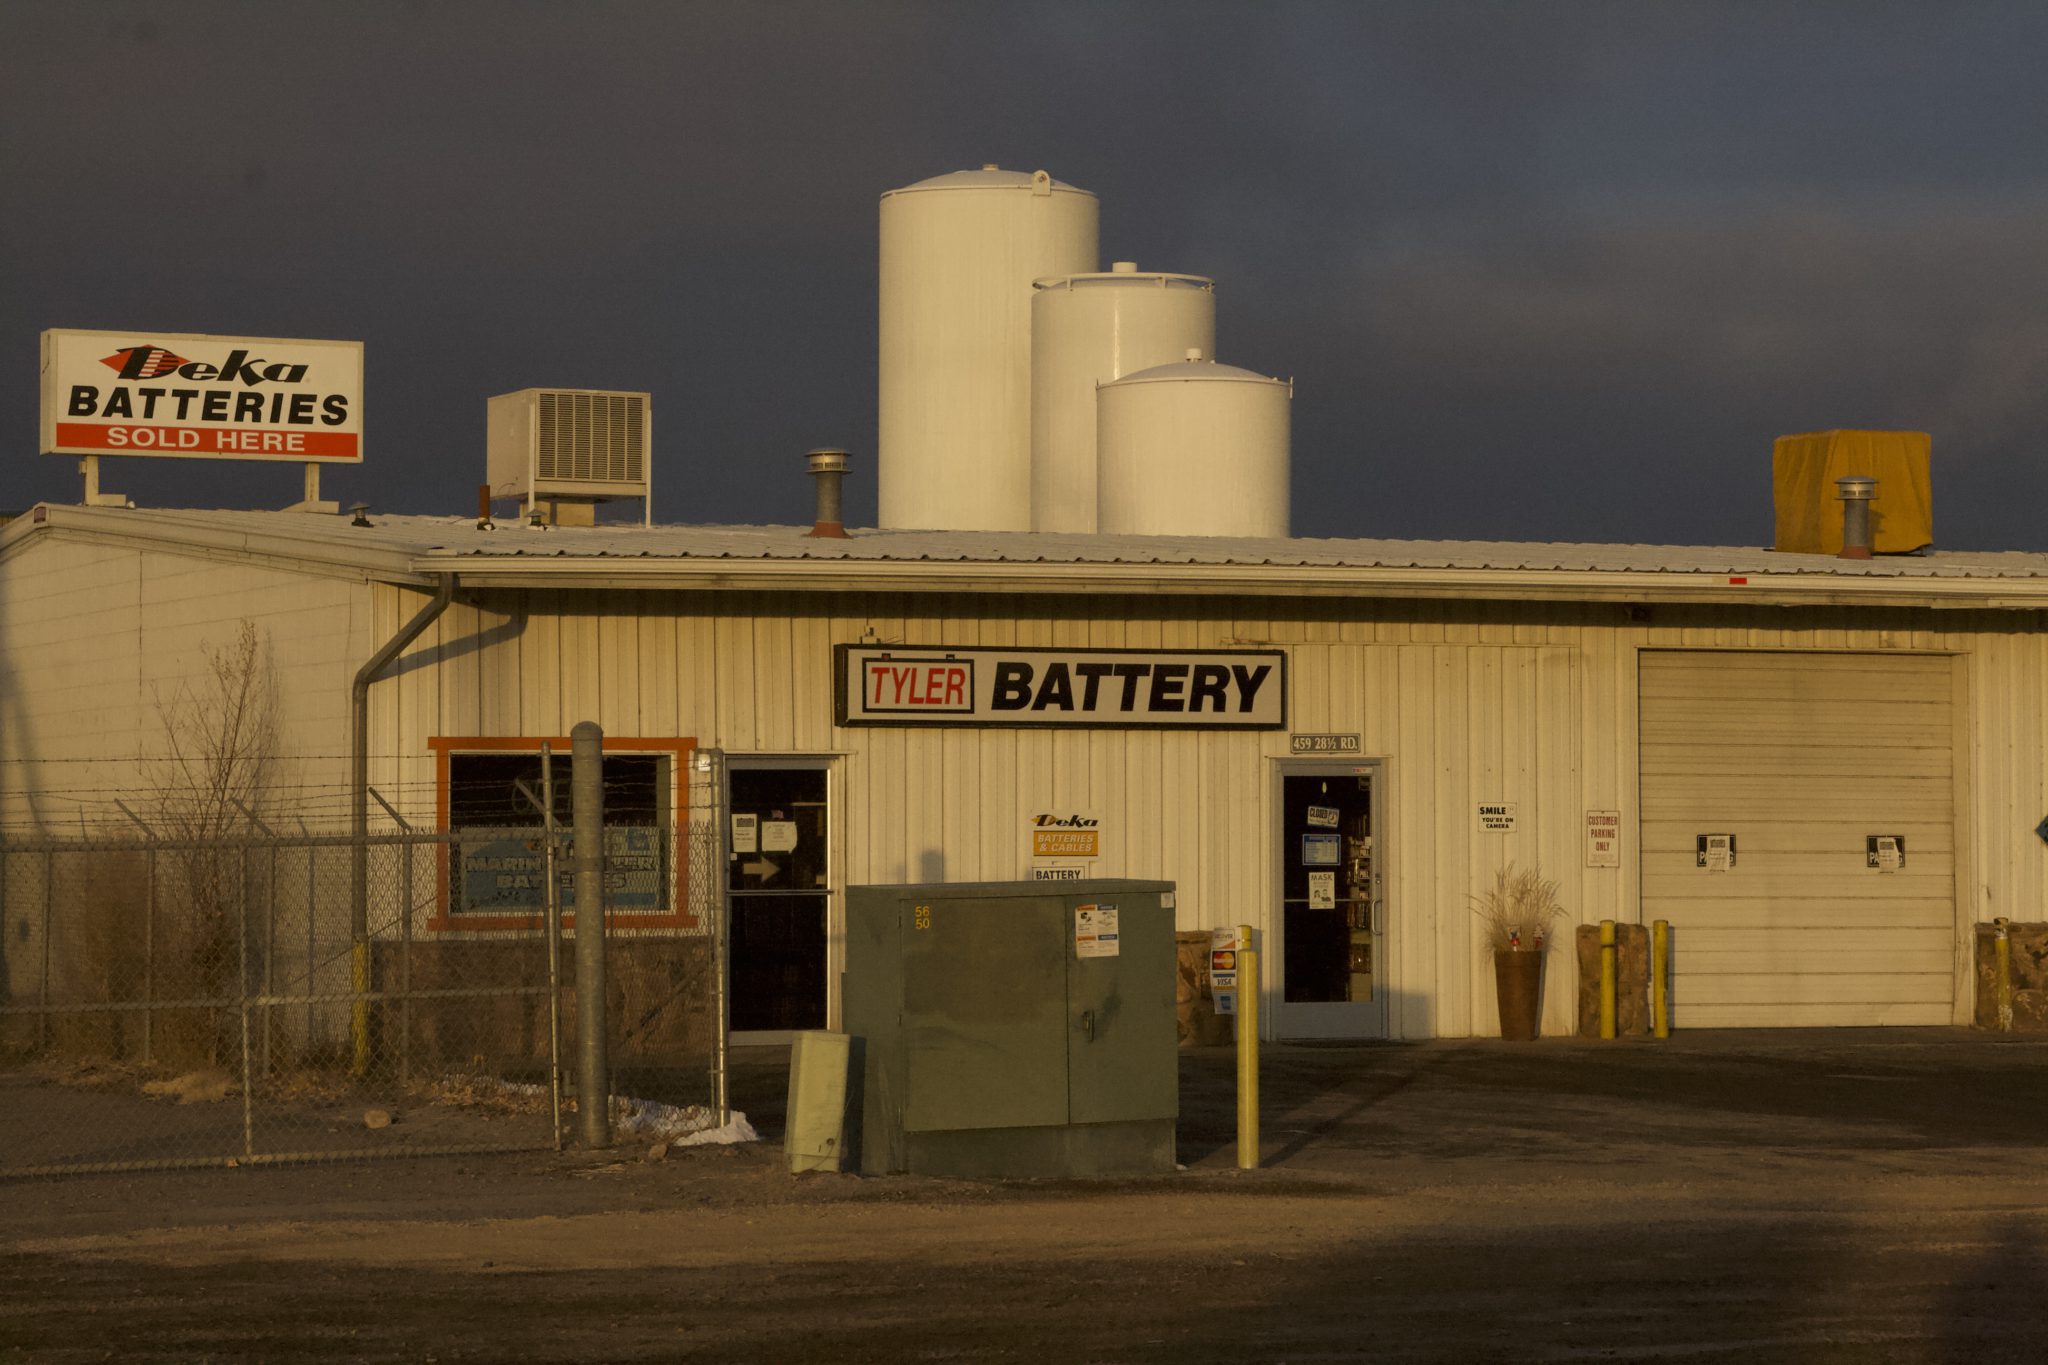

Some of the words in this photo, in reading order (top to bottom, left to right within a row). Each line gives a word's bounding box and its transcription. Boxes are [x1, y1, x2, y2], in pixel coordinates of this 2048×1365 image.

[115, 344, 309, 387] Deka
[67, 385, 349, 426] BATTERIES
[107, 427, 200, 448] SOLD
[216, 431, 305, 452] HERE
[871, 666, 966, 705] TYLER
[991, 661, 1272, 713] BATTERY
[1293, 737, 1312, 750] 459
[1340, 736, 1358, 750] RD.
[1479, 806, 1506, 815] SMILE
[1035, 814, 1098, 828] Deka
[1588, 815, 1618, 826] CUSTOMER
[1037, 834, 1094, 843] BATTERIES
[1590, 828, 1616, 839] PARKING
[1039, 843, 1048, 852] &
[1051, 843, 1093, 852] CABLES
[1595, 841, 1610, 852] ONLY
[1035, 870, 1081, 880] BATTERY
[1310, 873, 1333, 881] MASK
[914, 905, 930, 918] 56
[915, 917, 930, 930] 50
[1216, 978, 1232, 986] VISA
